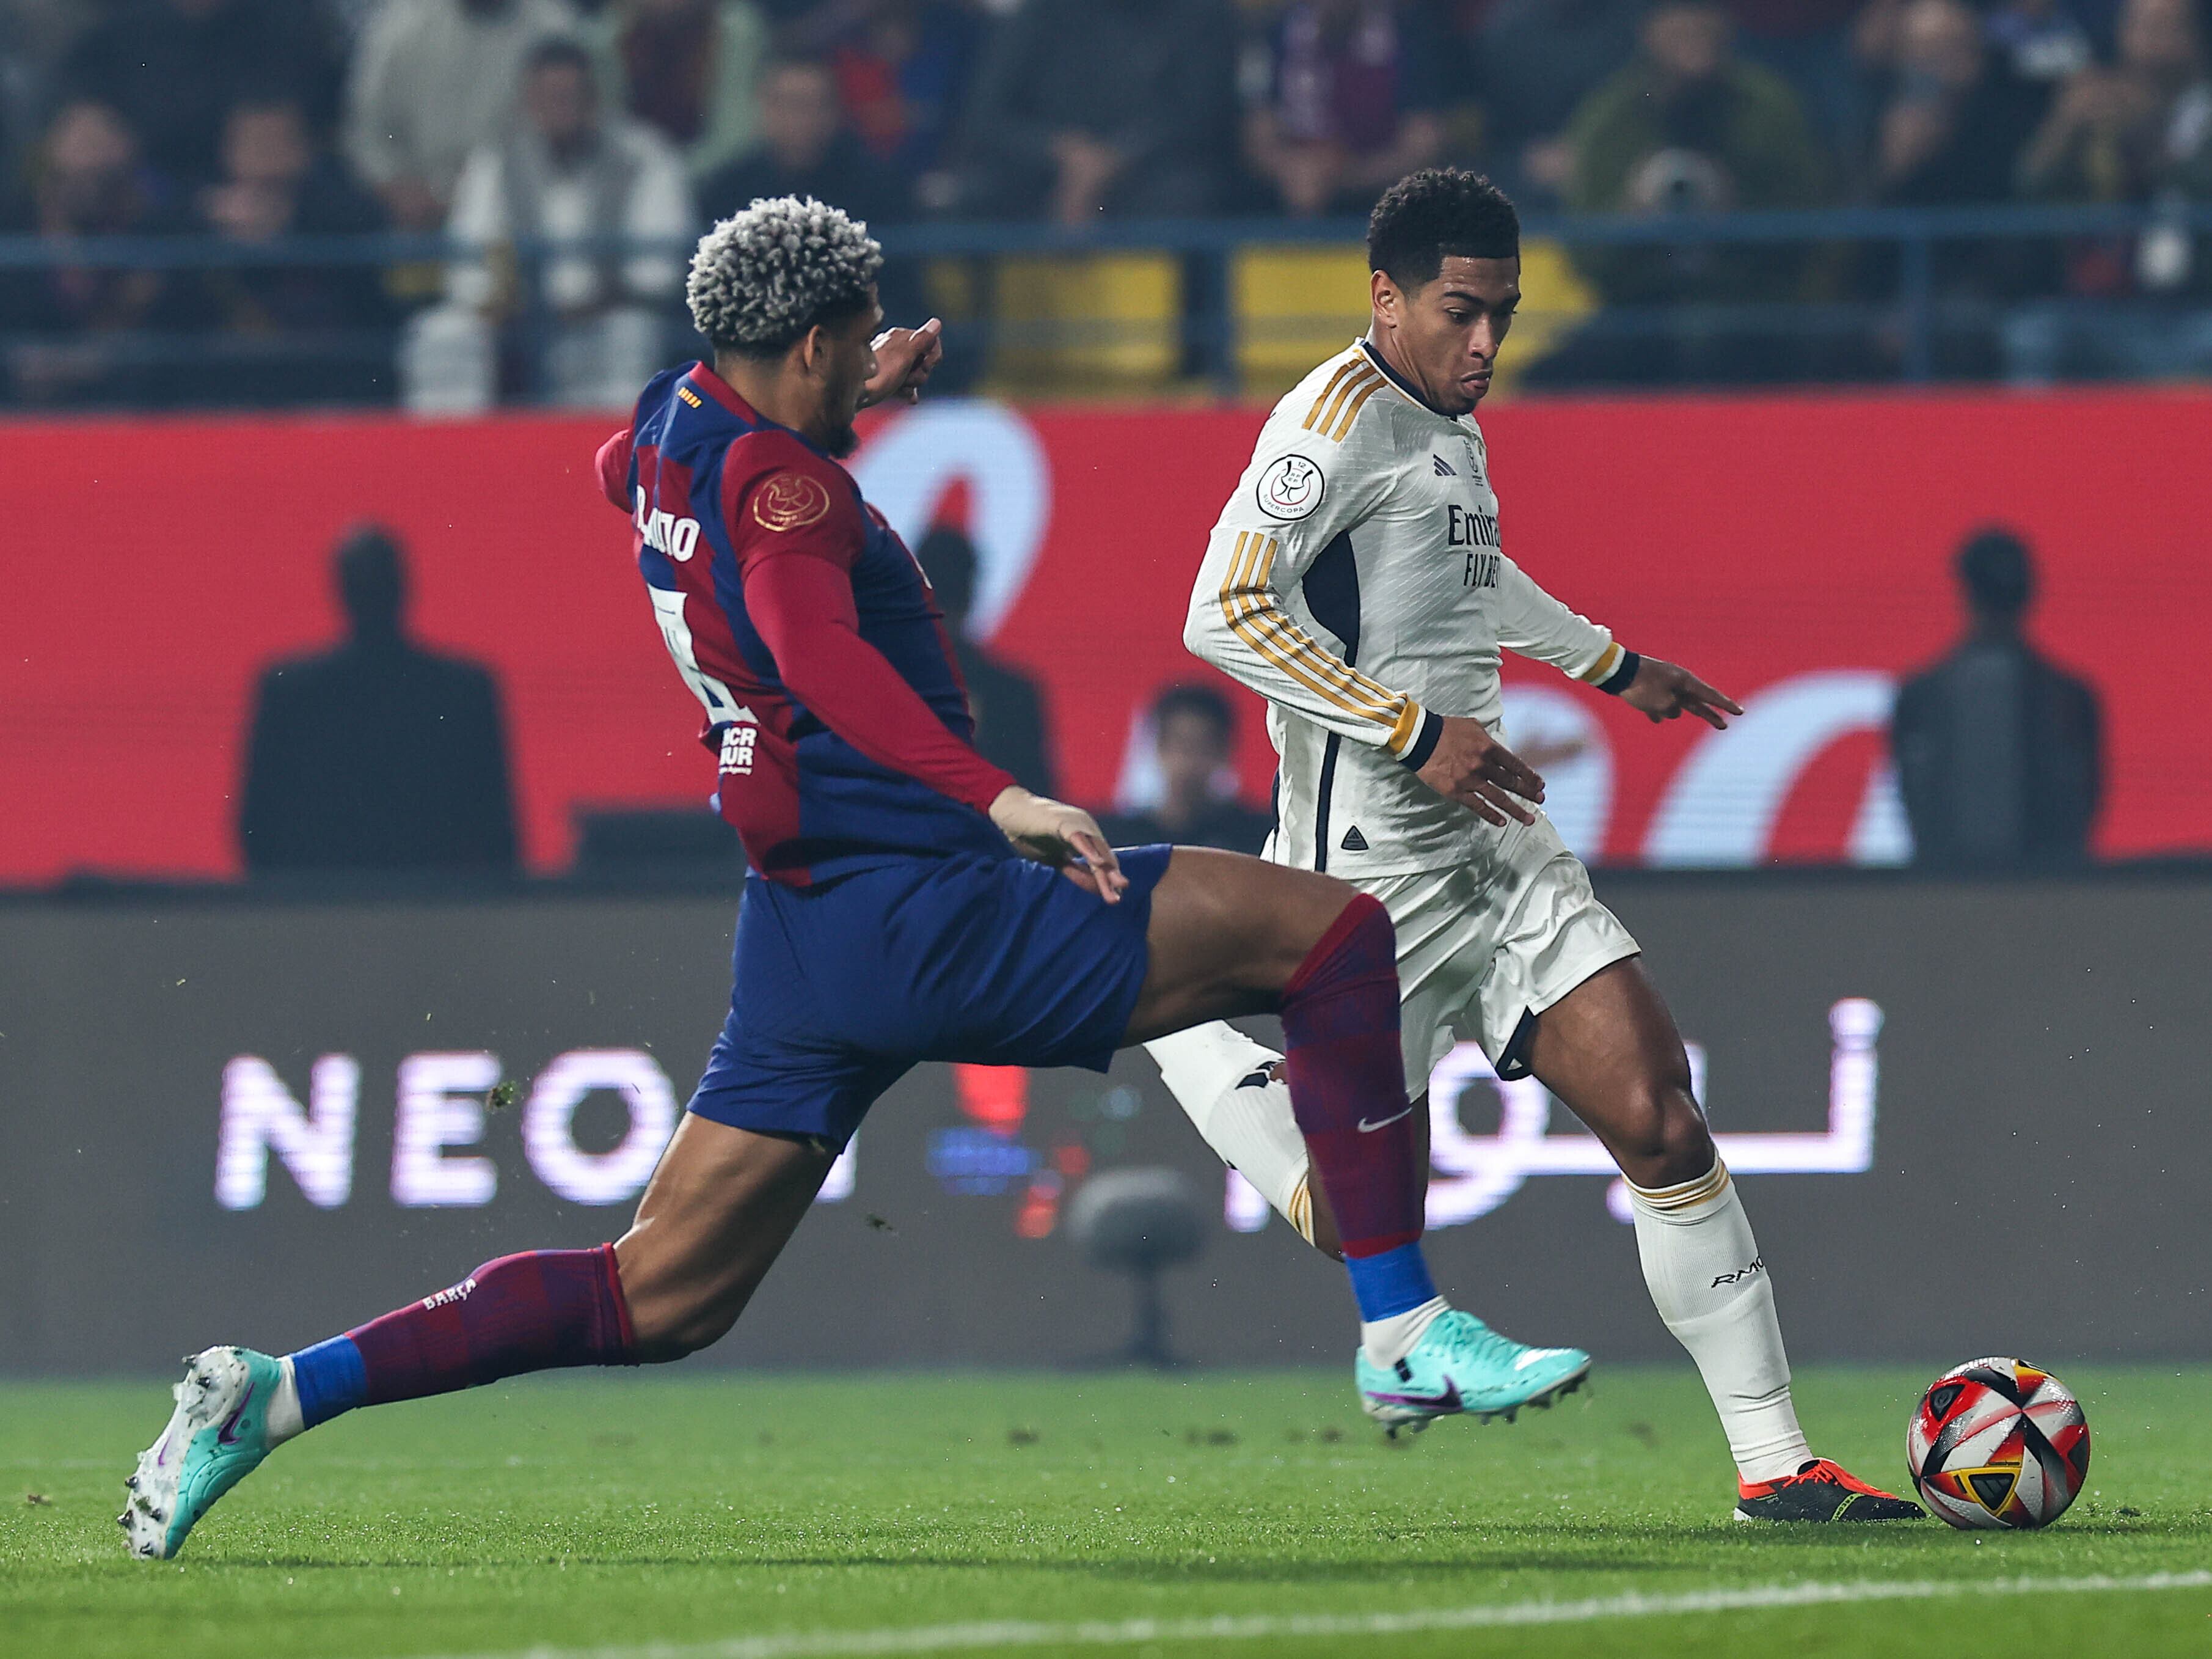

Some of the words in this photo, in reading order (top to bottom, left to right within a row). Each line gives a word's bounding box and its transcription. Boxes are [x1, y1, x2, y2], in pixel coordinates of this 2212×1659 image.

[1263, 494, 1305, 513] SUPERCOPA
[214, 1048, 858, 1210] NEO
[422, 1278, 476, 1311] BARÇA
